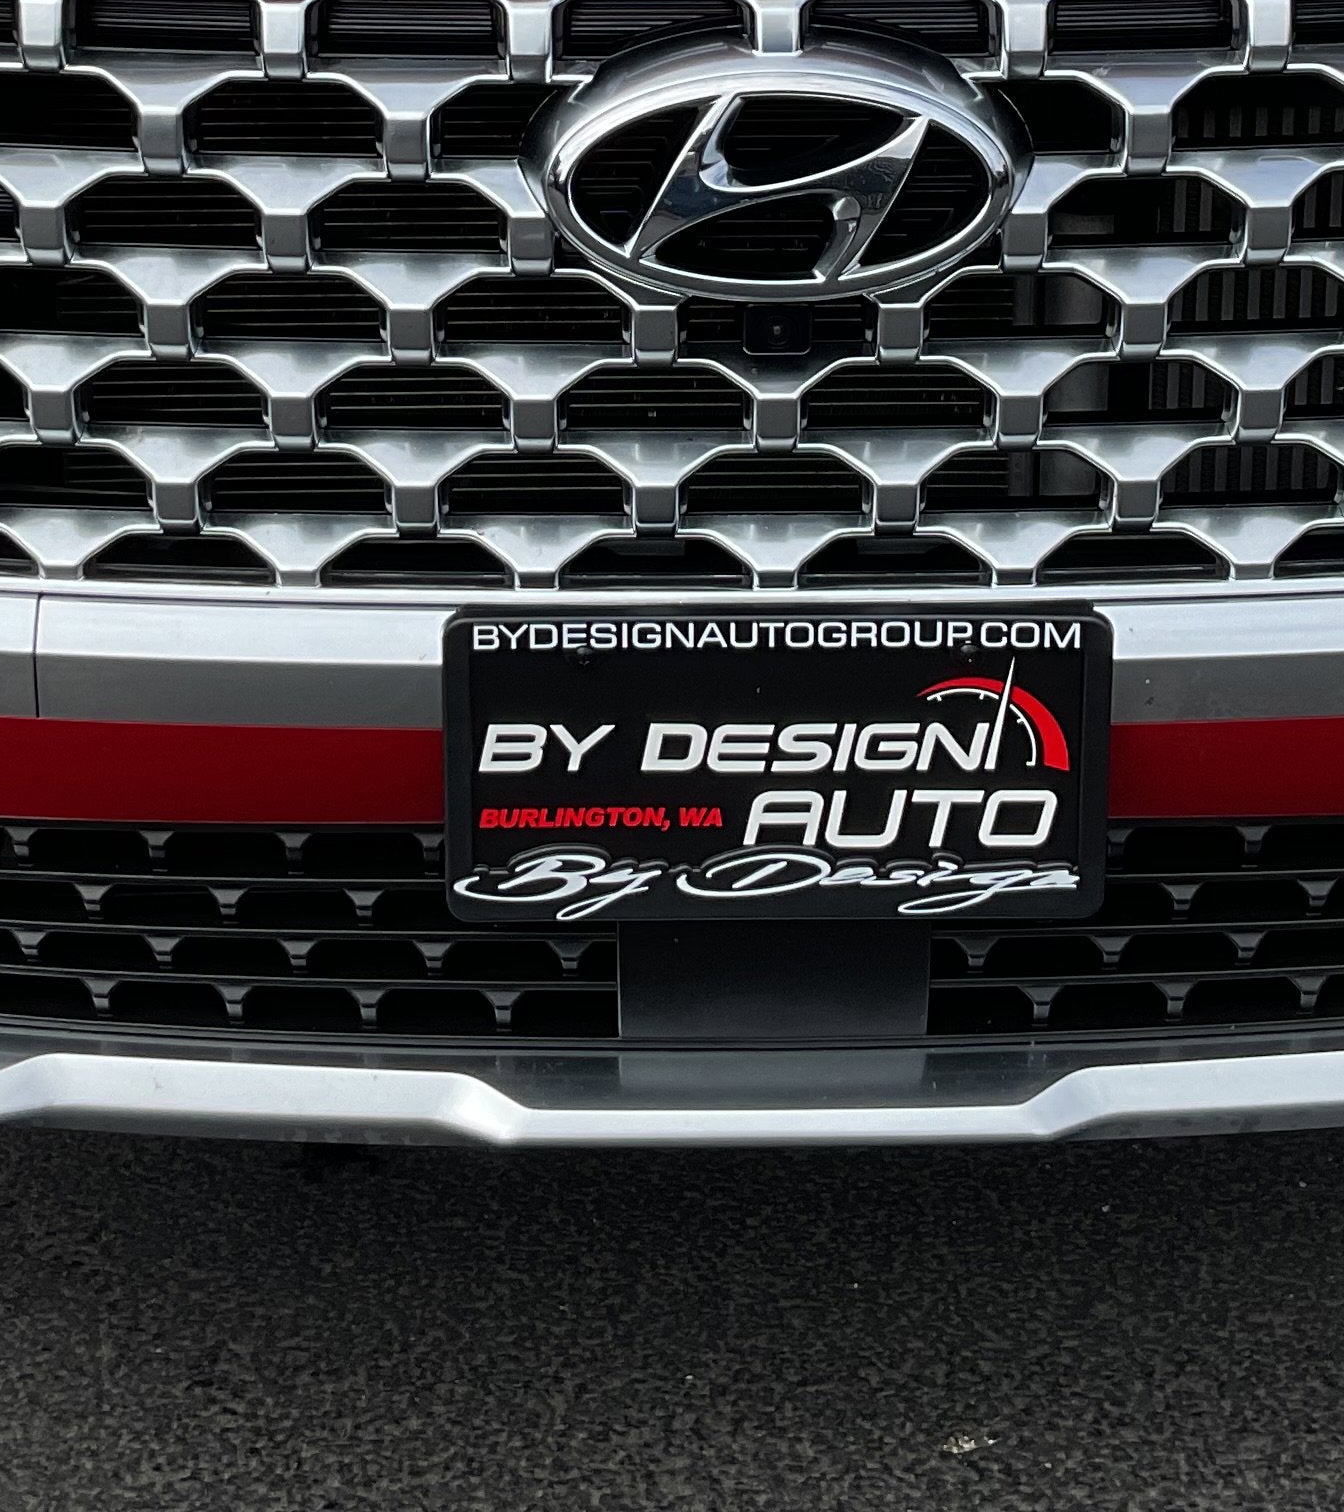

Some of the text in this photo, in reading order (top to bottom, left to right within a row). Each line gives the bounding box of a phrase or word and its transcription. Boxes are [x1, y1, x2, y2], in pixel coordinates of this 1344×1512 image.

[473, 620, 1081, 650] BYDESIGNAUTOGROUP.COM
[478, 721, 990, 772] BY DESIGN
[479, 806, 723, 832] BURLINGTON, WA
[742, 788, 1058, 848] AUTO
[453, 854, 662, 921] By
